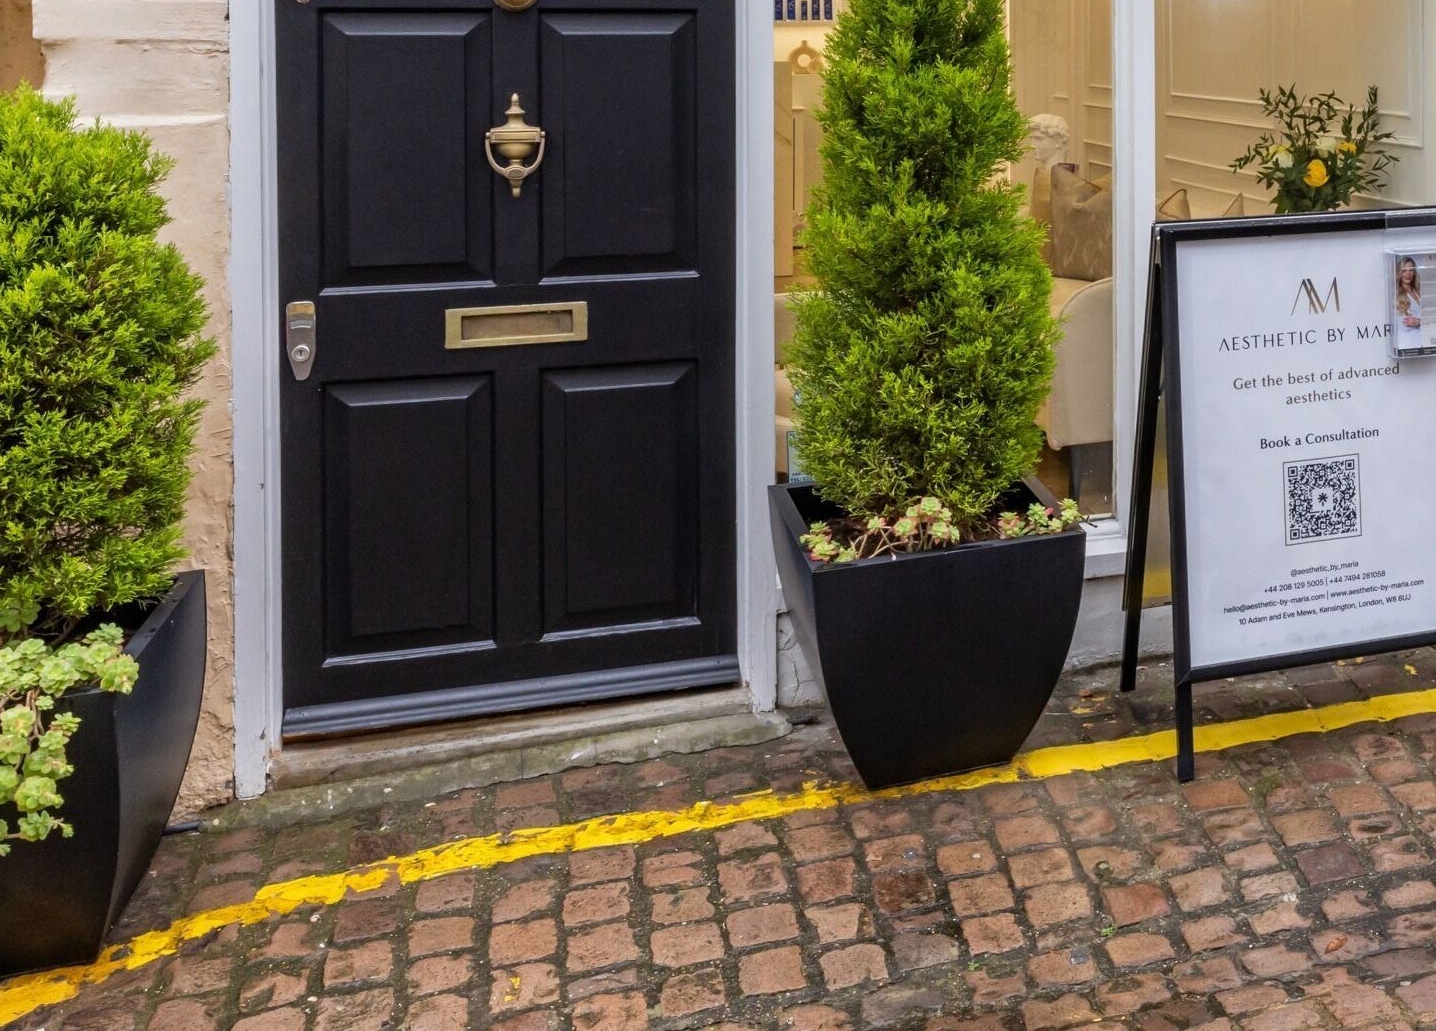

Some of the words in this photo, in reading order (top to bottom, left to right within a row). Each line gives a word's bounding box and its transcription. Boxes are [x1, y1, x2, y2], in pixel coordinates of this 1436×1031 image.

[1218, 329, 1317, 353] AESTHETIC
[1327, 327, 1347, 343] BY
[1356, 323, 1393, 339] MAR
[1233, 376, 1257, 391] Get
[1261, 373, 1284, 388] the
[1288, 370, 1316, 385] best
[1320, 368, 1335, 381] of
[1337, 362, 1401, 381] advanced
[1286, 388, 1352, 406] aesthetics
[1259, 436, 1291, 450] Book
[1294, 437, 1302, 447] a
[1304, 427, 1380, 446] Consultation
[1264, 584, 1278, 594] +44
[1279, 582, 1293, 592] 208
[1294, 581, 1306, 590] 129
[1306, 578, 1325, 588] 5005
[1329, 575, 1343, 585] +44
[1362, 570, 1386, 580] 281058
[1290, 560, 1359, 578] @aesthetic_by_maria
[1223, 592, 1326, 614] hello@aesthetic-by-maria.com
[1330, 579, 1425, 599] www.aesthetic-by-maria.com
[1238, 618, 1247, 626] 10
[1247, 615, 1268, 625] Adam
[1268, 612, 1282, 622] and
[1282, 610, 1296, 620] Eve
[1296, 607, 1318, 619] Mews,
[1319, 602, 1358, 615] Kensington,
[1358, 597, 1385, 609] London,
[1386, 595, 1398, 605] W8
